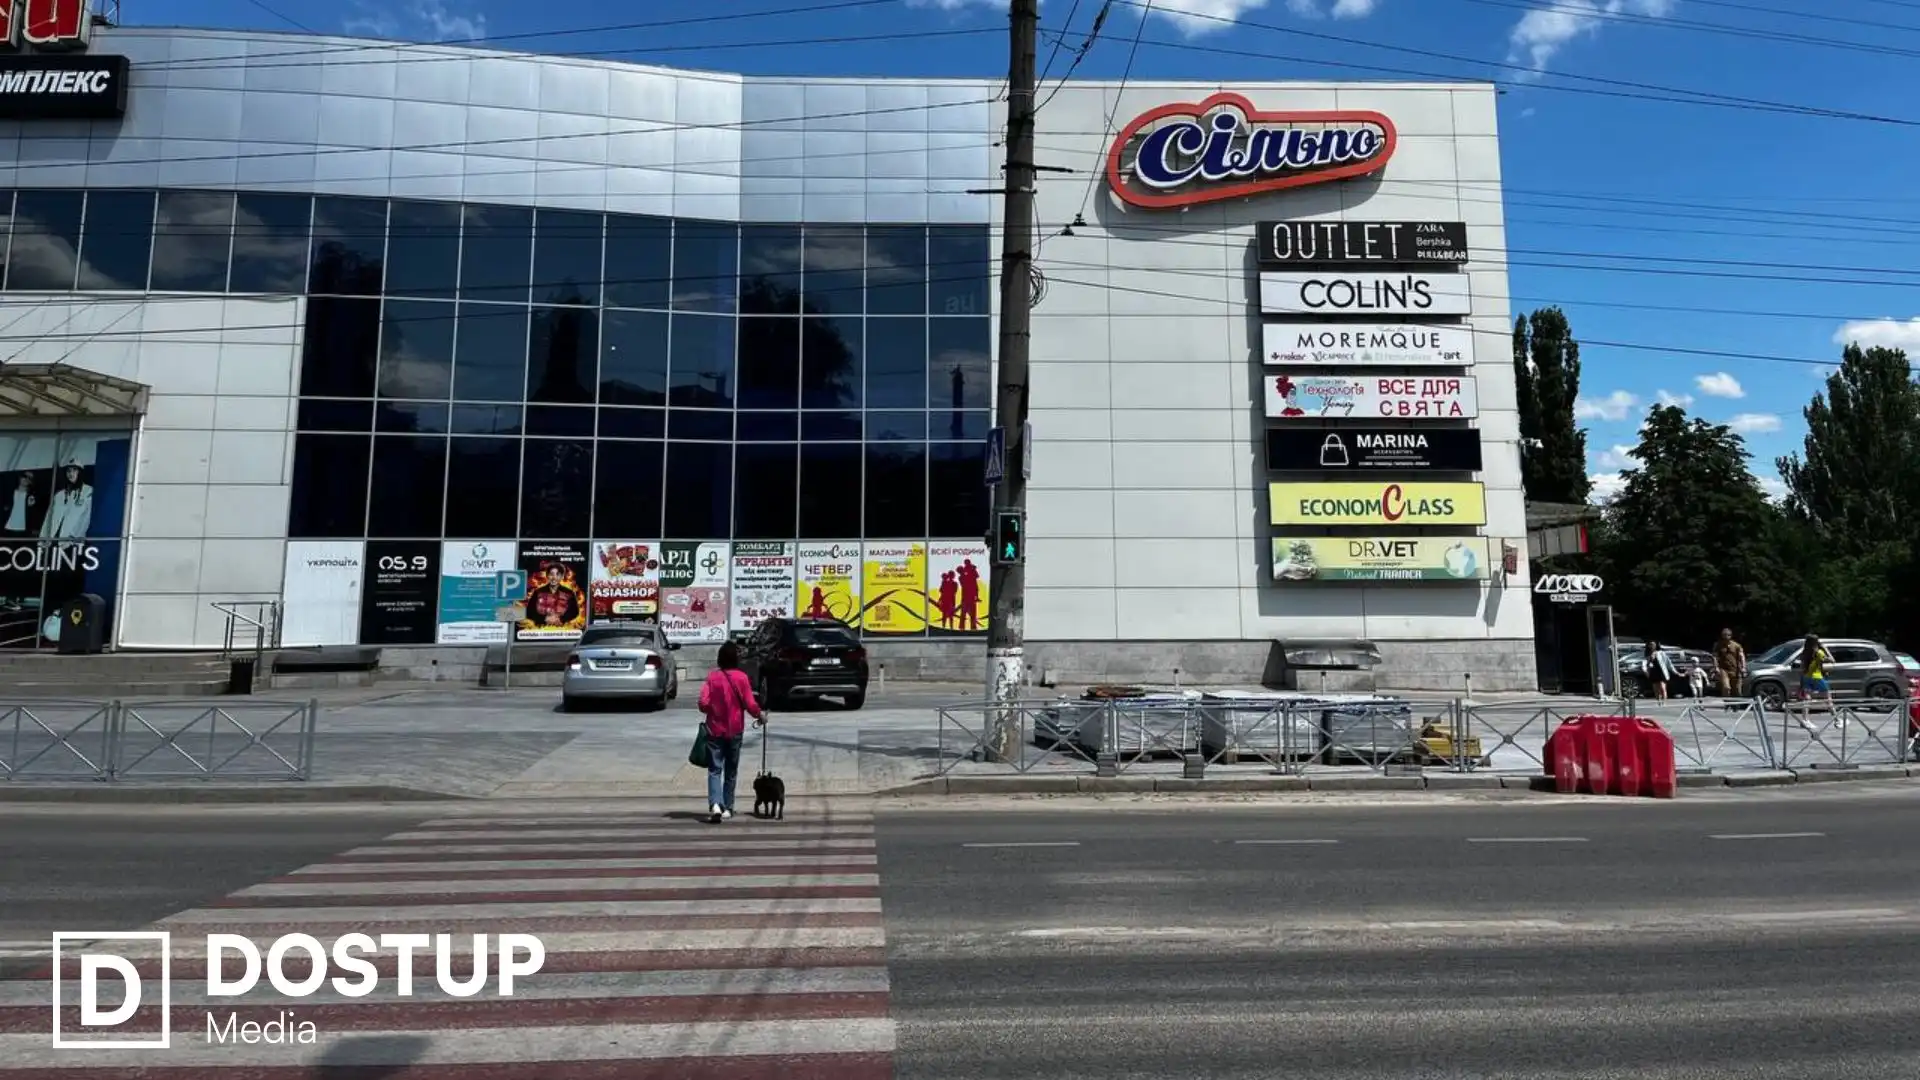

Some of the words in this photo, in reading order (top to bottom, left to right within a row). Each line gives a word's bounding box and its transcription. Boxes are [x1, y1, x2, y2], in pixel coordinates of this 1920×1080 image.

[0, 70, 111, 93] МПЛЕКС
[1135, 112, 1382, 188] Сільпо
[1416, 224, 1445, 233] ZARA
[1273, 223, 1402, 259] OUTLET
[1416, 237, 1452, 247] Bershka
[1300, 275, 1433, 308] COLIN'S
[1297, 332, 1441, 349] MOREMQUE
[1378, 379, 1416, 395] ВСЕ
[1421, 379, 1461, 398] ДЛЯ
[1379, 401, 1463, 416] СВЯТА
[1357, 434, 1429, 448] MARINA
[1300, 484, 1454, 521] ECONOMCLASS
[0, 543, 99, 571] COLIN'S
[1349, 541, 1418, 557] DR.VET
[735, 557, 792, 567] КРЕДИТИ
[805, 564, 852, 575] ЧЕТВЕР
[502, 572, 521, 598] P
[593, 587, 658, 598] ASIASHOP
